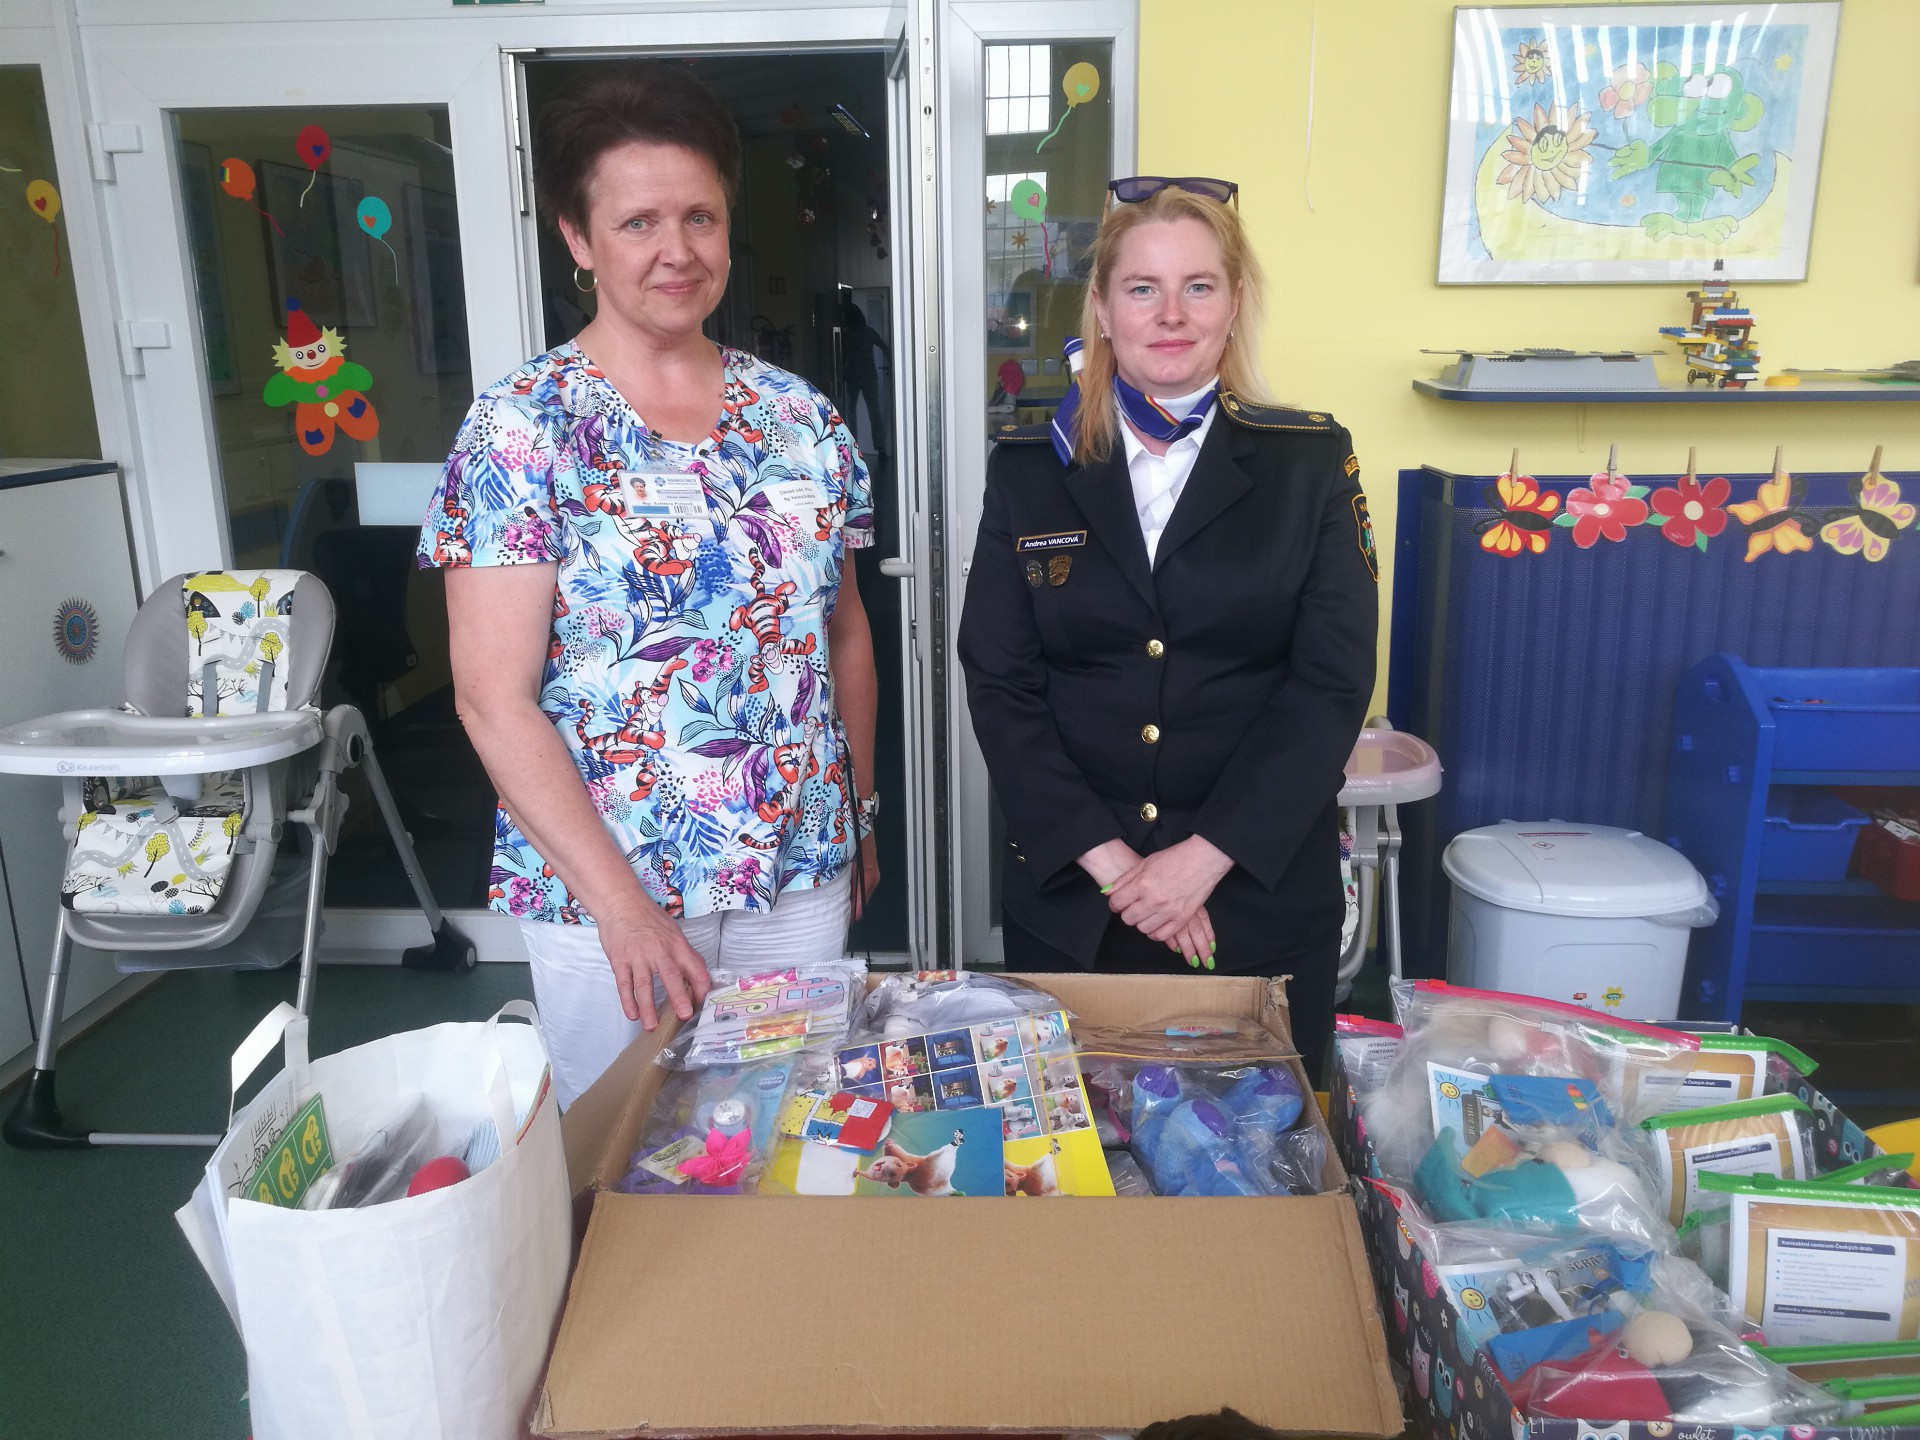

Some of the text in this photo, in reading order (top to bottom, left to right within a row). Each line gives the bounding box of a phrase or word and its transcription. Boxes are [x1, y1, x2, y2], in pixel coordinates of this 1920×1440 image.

[1024, 535, 1079, 548] Andrea VANCOVÁ
[1834, 1243, 1858, 1251] Českých
[1678, 1424, 1717, 1440] owlet
